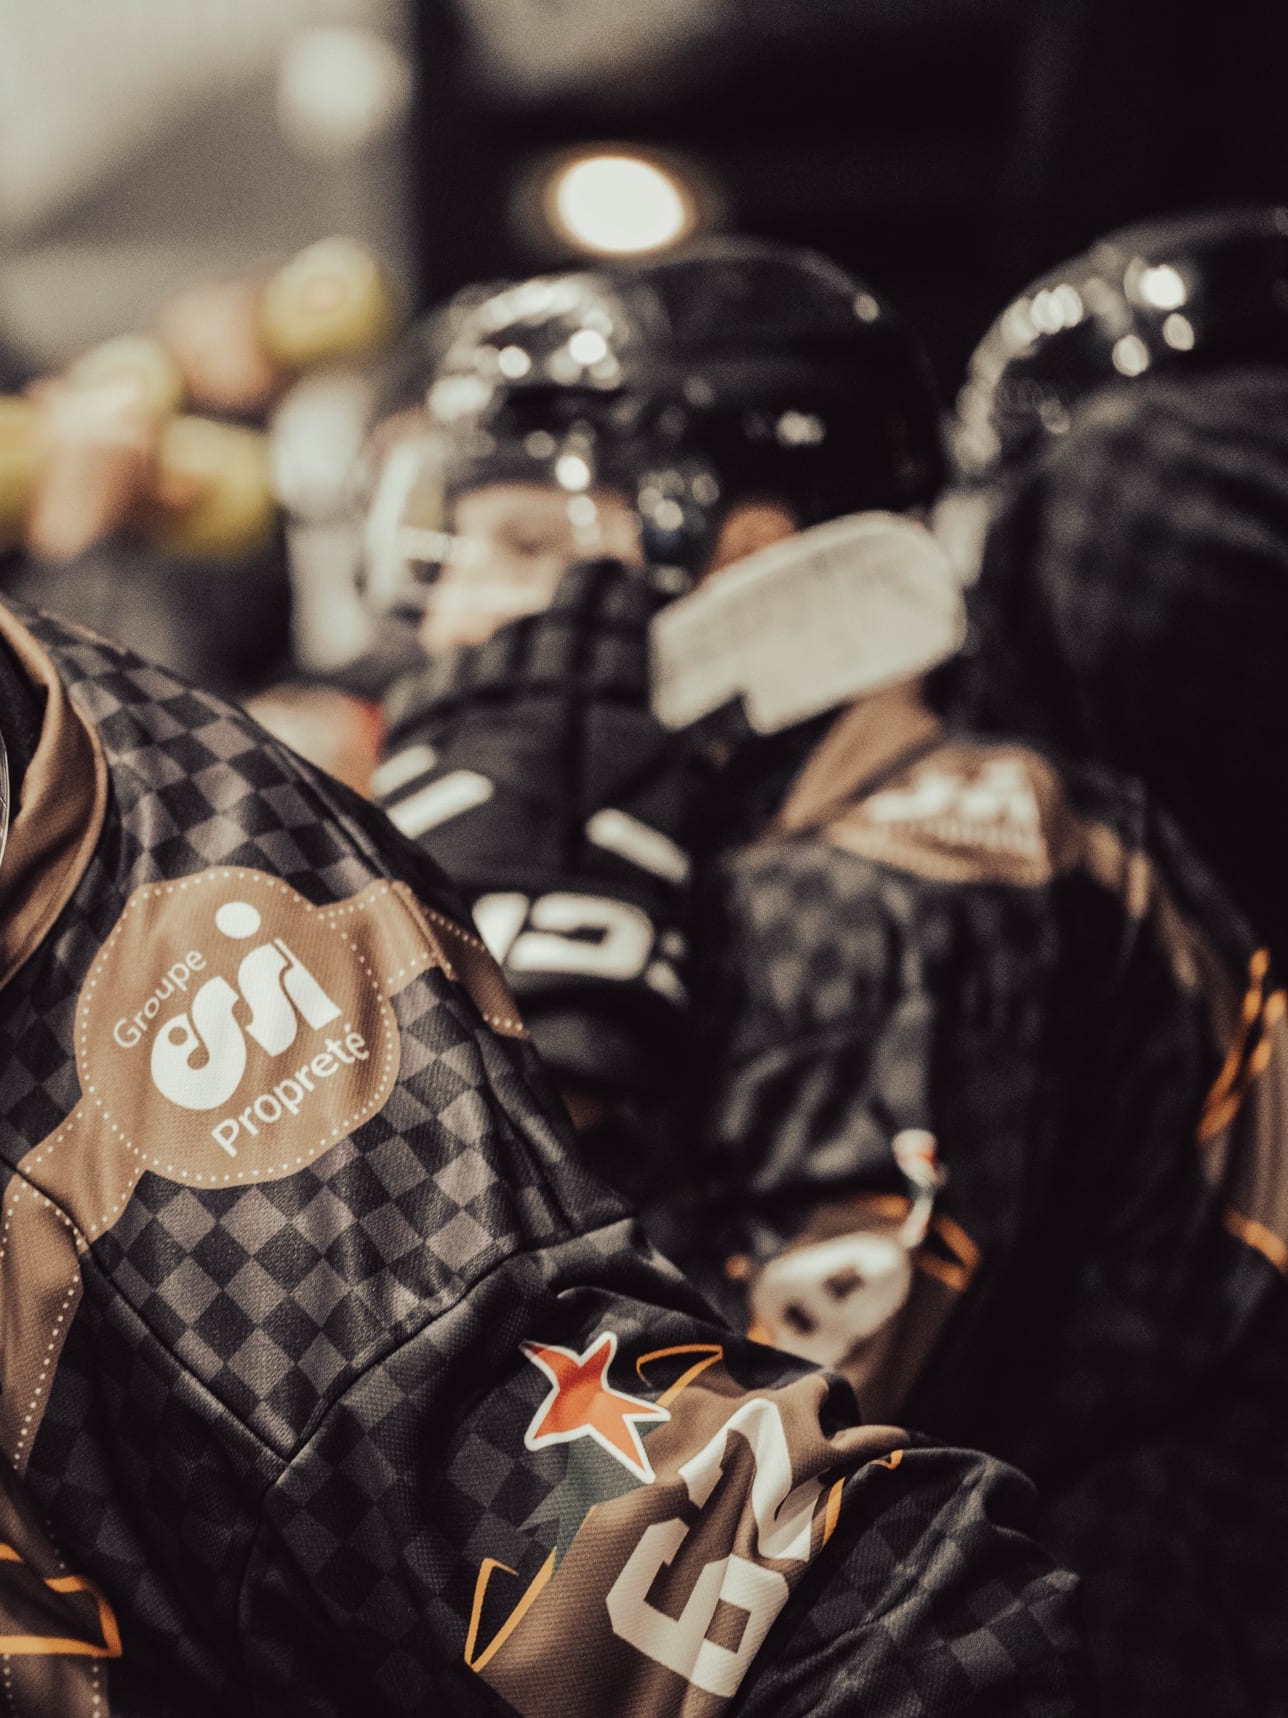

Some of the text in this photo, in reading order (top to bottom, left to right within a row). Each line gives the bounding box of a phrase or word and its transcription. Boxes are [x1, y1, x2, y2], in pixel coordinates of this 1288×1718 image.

[113, 951, 208, 1048] Groupe
[212, 1023, 370, 1158] Propreté
[606, 1398, 819, 1697] 62
